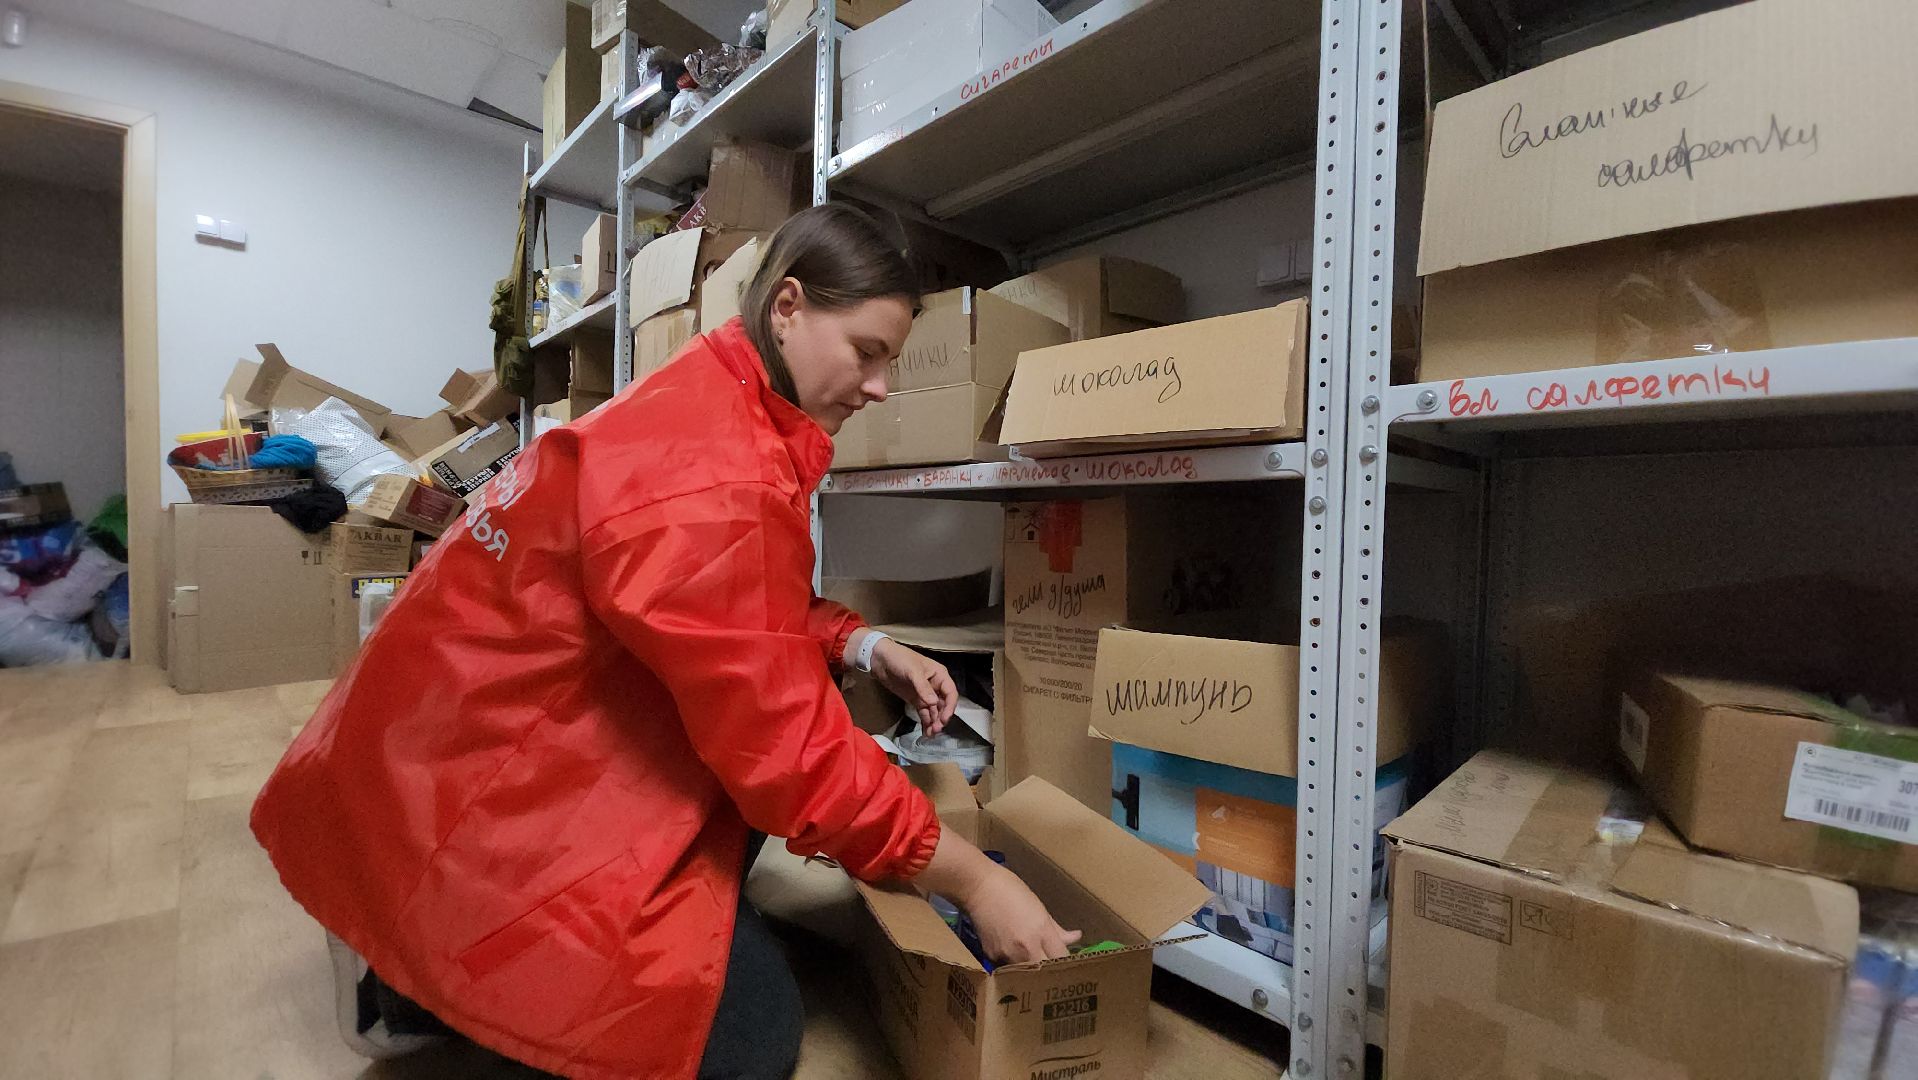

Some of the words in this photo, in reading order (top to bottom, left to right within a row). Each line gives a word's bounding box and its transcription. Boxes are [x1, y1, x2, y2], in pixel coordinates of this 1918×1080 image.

[689, 205, 708, 229] AKB
[1526, 364, 1771, 411] салфетки
[352, 529, 402, 543] AKBAR
[1030, 1060, 1102, 1080] Мистраль
